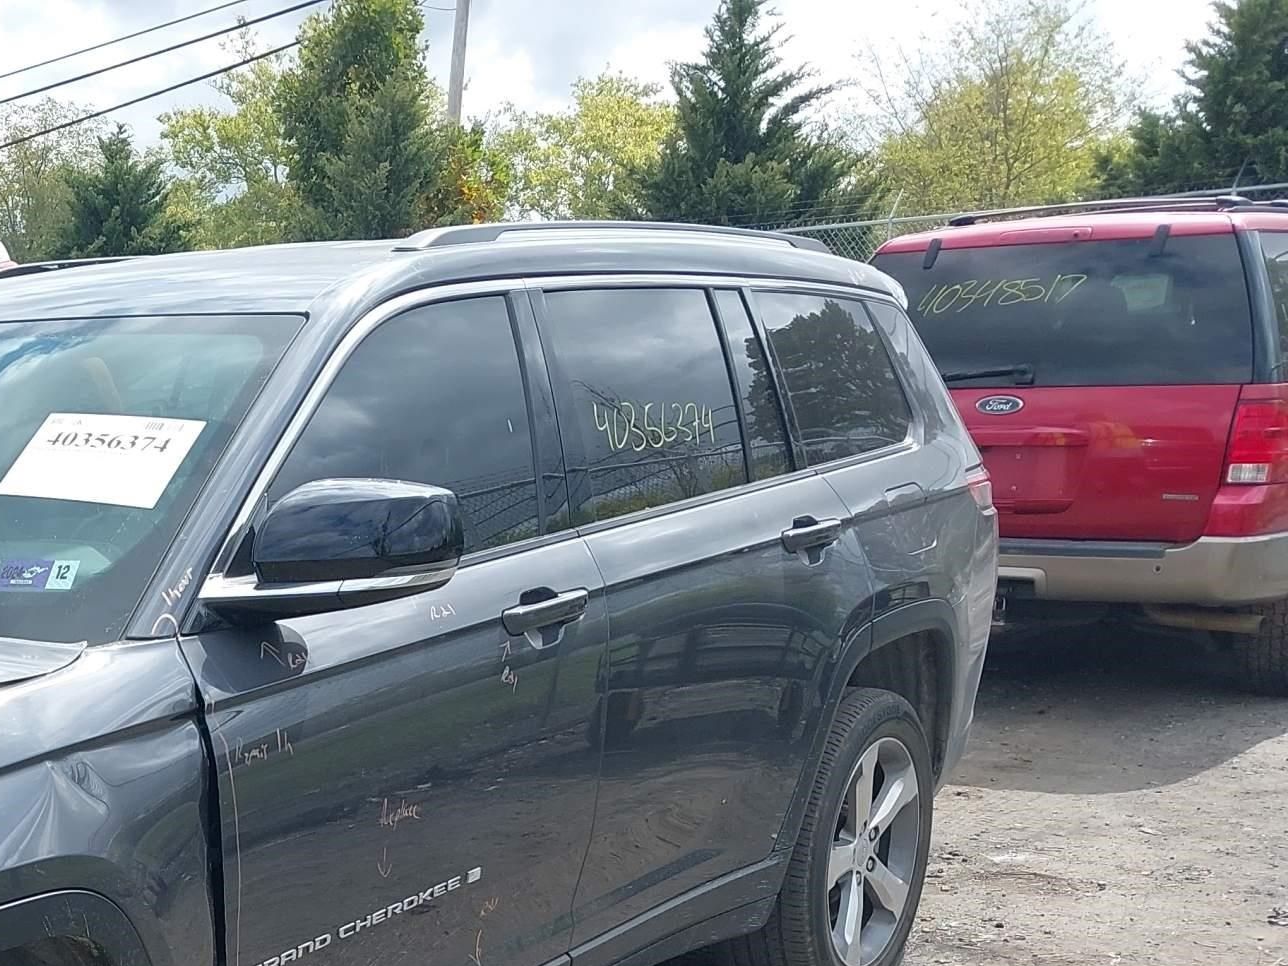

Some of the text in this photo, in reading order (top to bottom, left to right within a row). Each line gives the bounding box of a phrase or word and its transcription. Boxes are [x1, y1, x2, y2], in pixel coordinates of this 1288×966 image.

[916, 273, 1089, 318] 40348517
[985, 398, 1013, 411] Ford
[46, 430, 172, 453] 40356374
[591, 401, 715, 452] 40356374
[55, 564, 71, 580] 12
[338, 874, 462, 940] CHEROKEE
